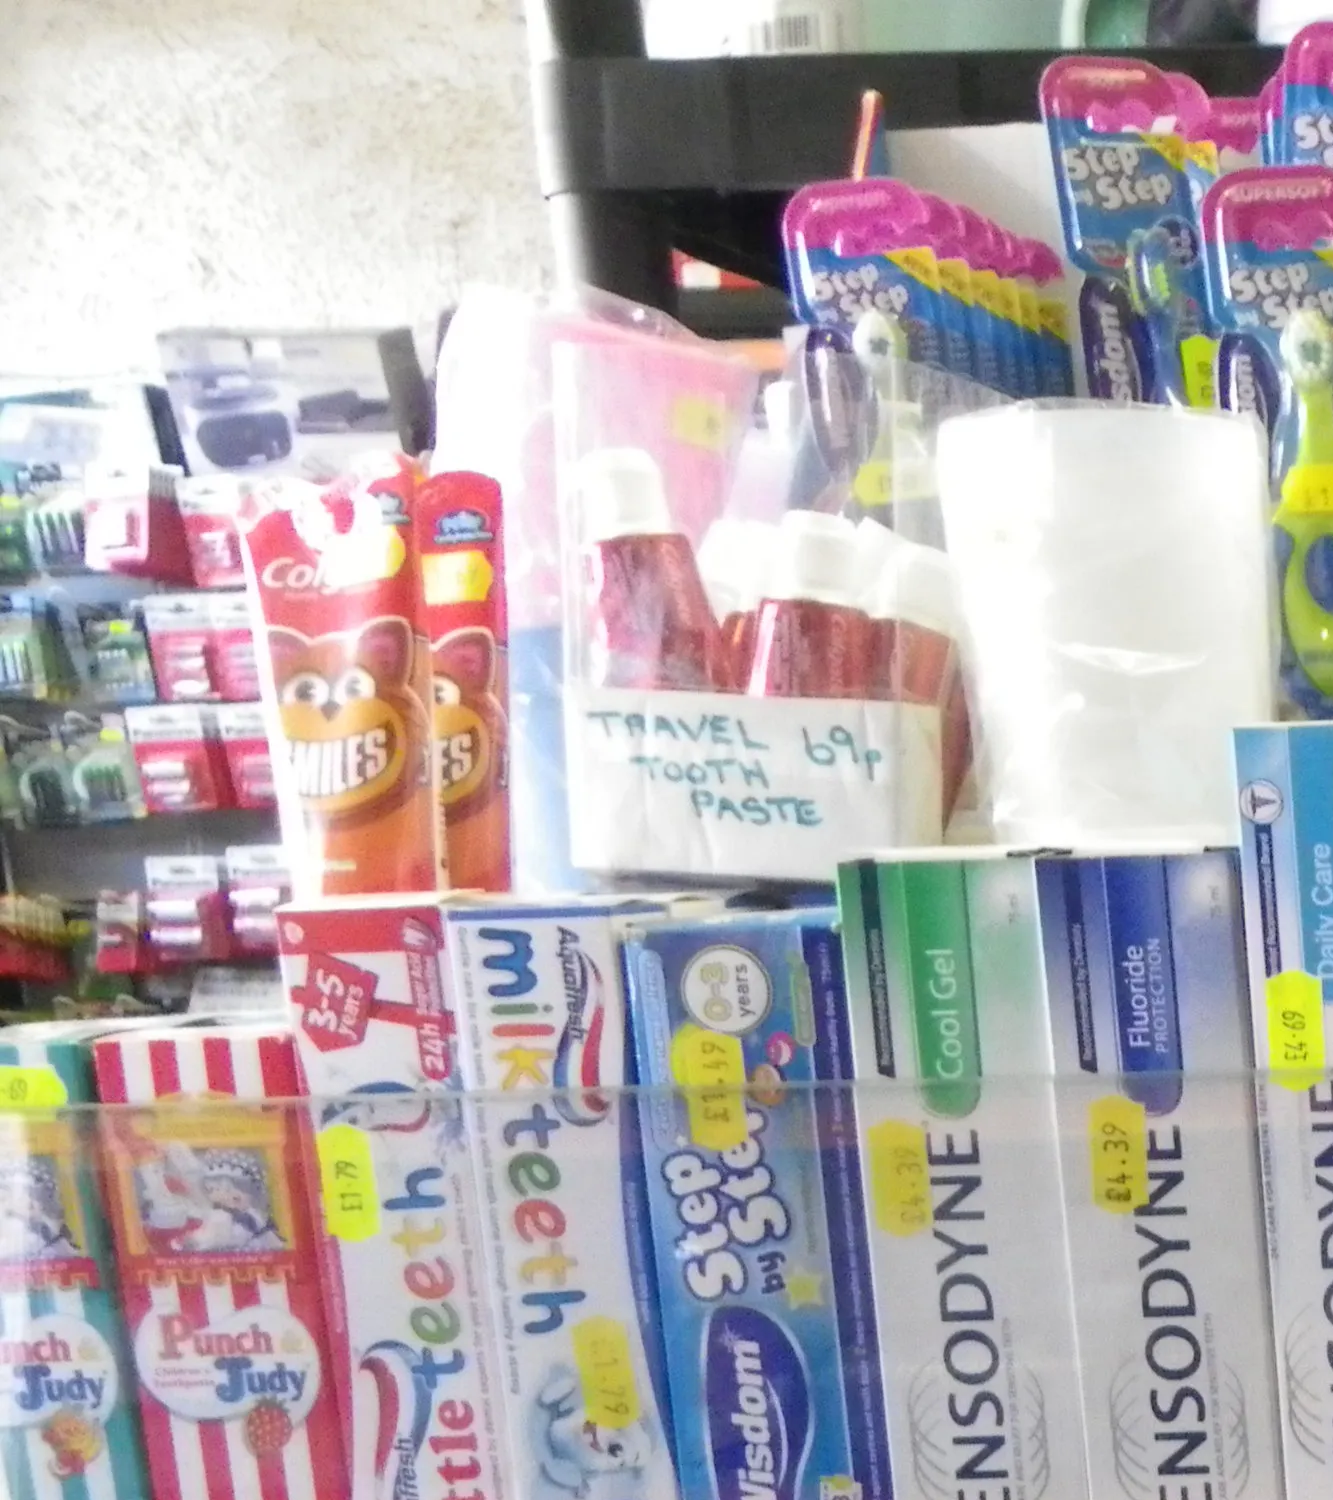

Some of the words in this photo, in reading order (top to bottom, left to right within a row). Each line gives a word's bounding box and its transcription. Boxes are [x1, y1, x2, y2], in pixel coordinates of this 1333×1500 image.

[1230, 265, 1309, 302] Step
[587, 710, 769, 751] TRAVEL
[629, 758, 770, 789] TOOTH
[691, 790, 824, 826] PASTE
[1310, 841, 1332, 907] Care
[699, 962, 730, 1022] 0-3
[736, 964, 762, 1019] years
[925, 949, 957, 1000] Gel
[1121, 944, 1153, 1050] Fluoride
[1145, 937, 1166, 1054] PROTECTION
[479, 926, 557, 1090] milk
[931, 1010, 964, 1080] Cool
[384, 1165, 465, 1390] teeth
[215, 1356, 310, 1402] Judy
